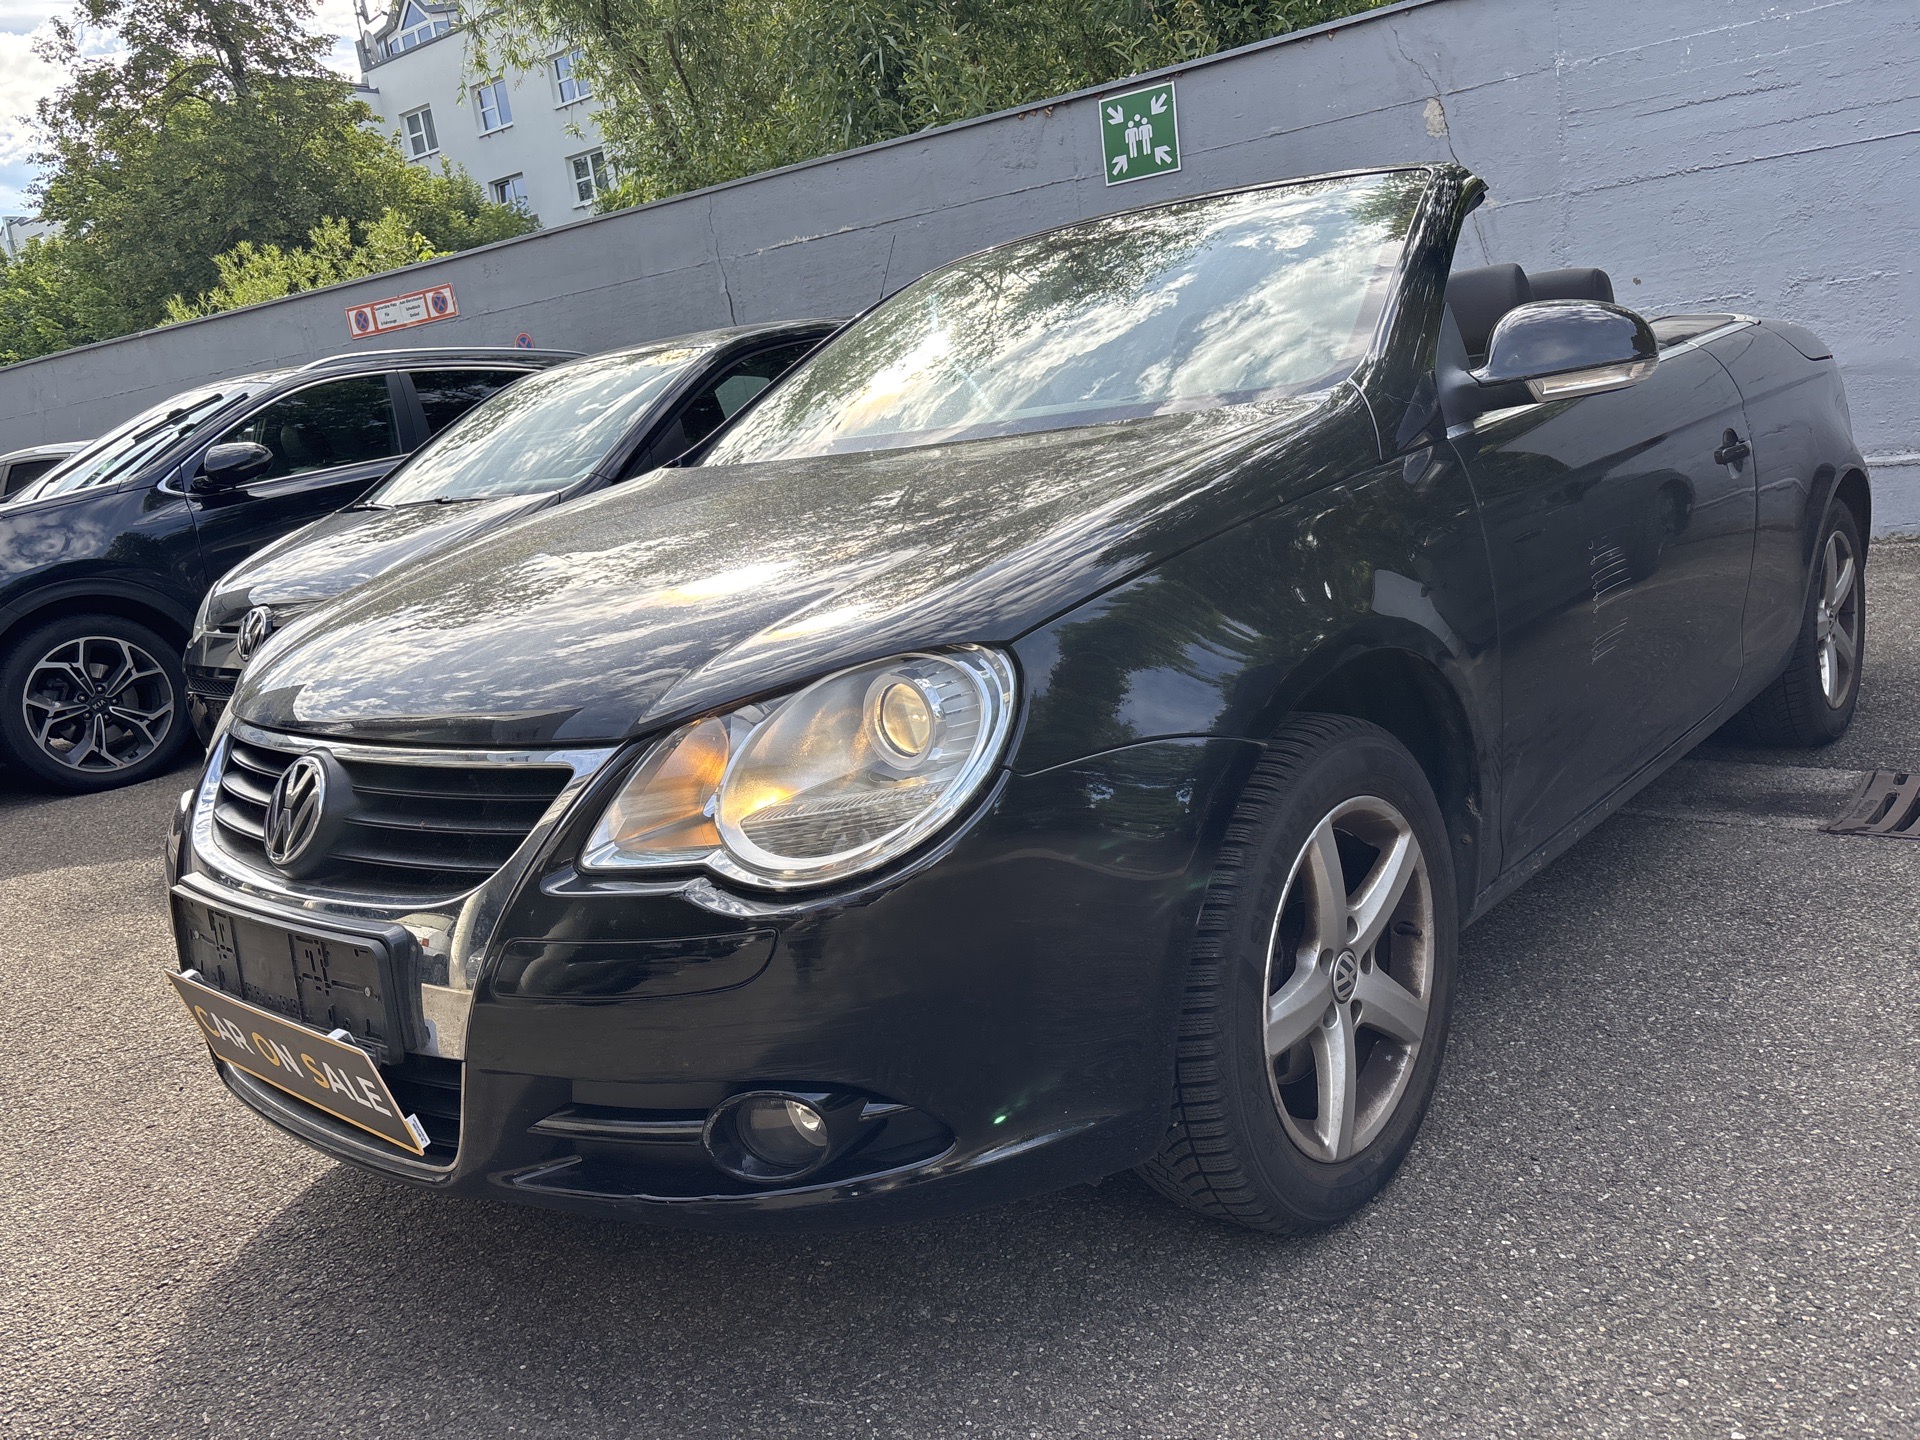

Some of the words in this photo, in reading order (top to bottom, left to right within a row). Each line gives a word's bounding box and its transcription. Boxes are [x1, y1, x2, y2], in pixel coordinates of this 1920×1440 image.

[92, 700, 106, 709] KIA
[264, 755, 325, 866] VW
[194, 1005, 255, 1055] CAR
[251, 1032, 304, 1078] ON
[300, 1053, 392, 1117] SALE
